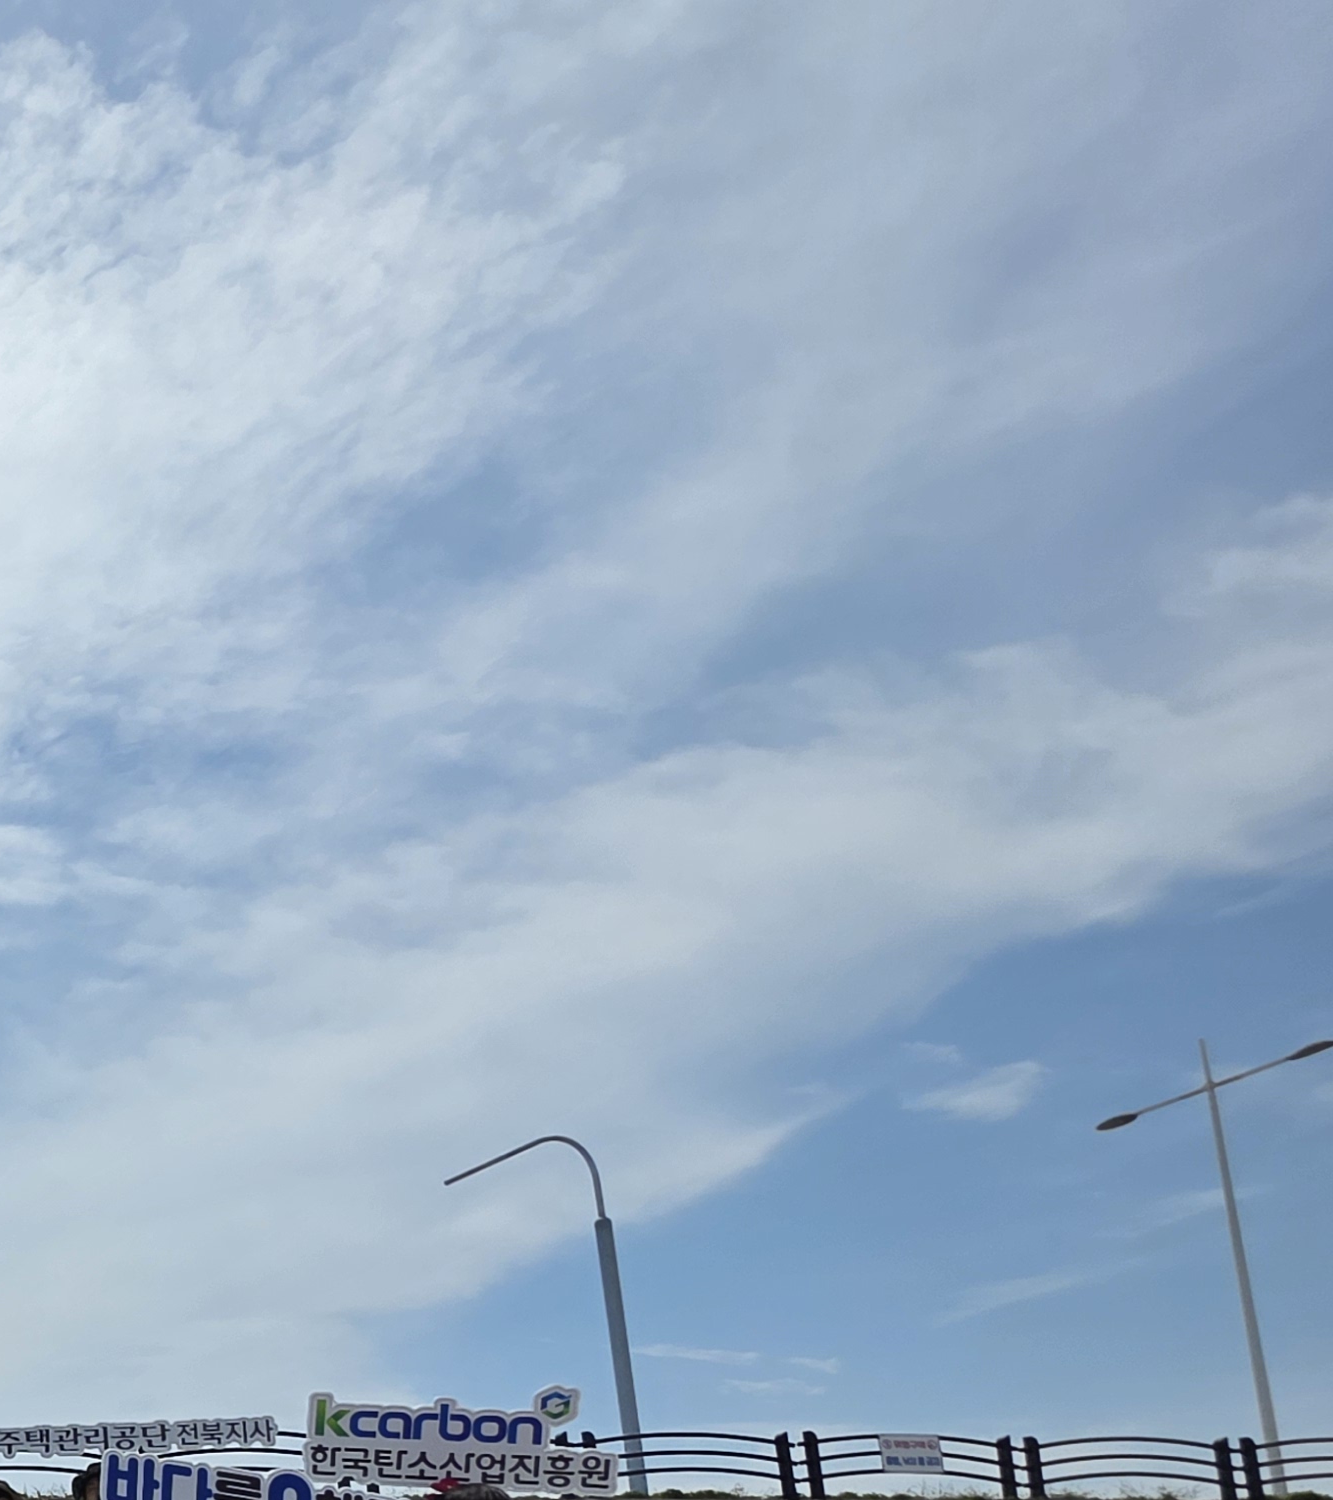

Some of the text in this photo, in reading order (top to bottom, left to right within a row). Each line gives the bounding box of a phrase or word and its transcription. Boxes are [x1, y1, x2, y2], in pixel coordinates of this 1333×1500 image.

[176, 1418, 276, 1446] 전북지사
[314, 1399, 543, 1446] kcarbon
[310, 1443, 612, 1489] 한국탄소산업진흥원
